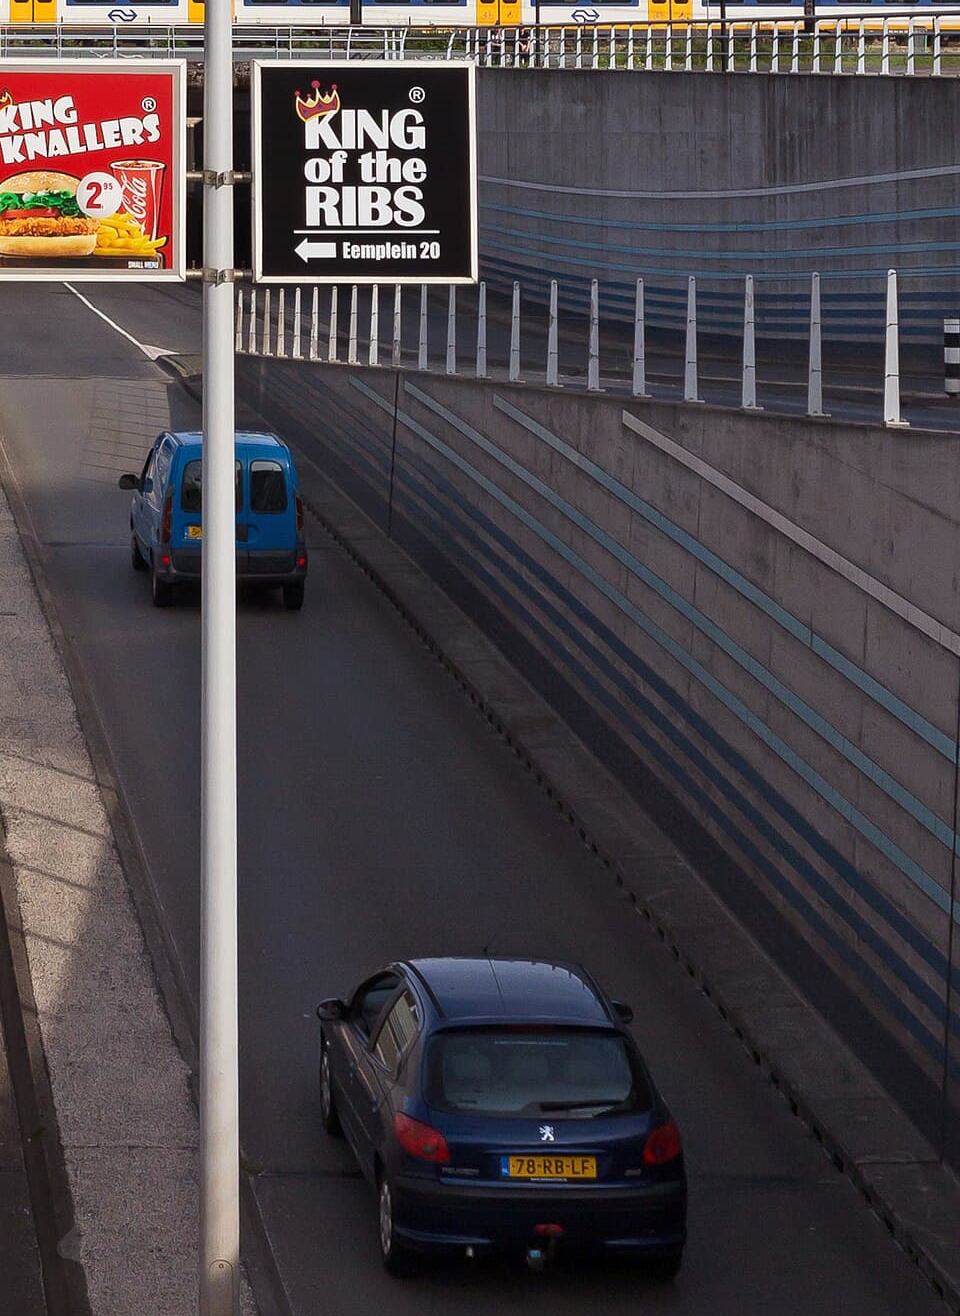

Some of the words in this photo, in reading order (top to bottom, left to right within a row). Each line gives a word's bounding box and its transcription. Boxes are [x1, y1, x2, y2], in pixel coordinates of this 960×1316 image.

[304, 108, 426, 150] KING
[304, 150, 348, 183] of
[358, 150, 427, 183] the
[305, 185, 426, 227] RIBS
[342, 242, 417, 261] Eemplein
[419, 242, 441, 260] 20
[514, 1158, 590, 1175] 78-RB-LF
